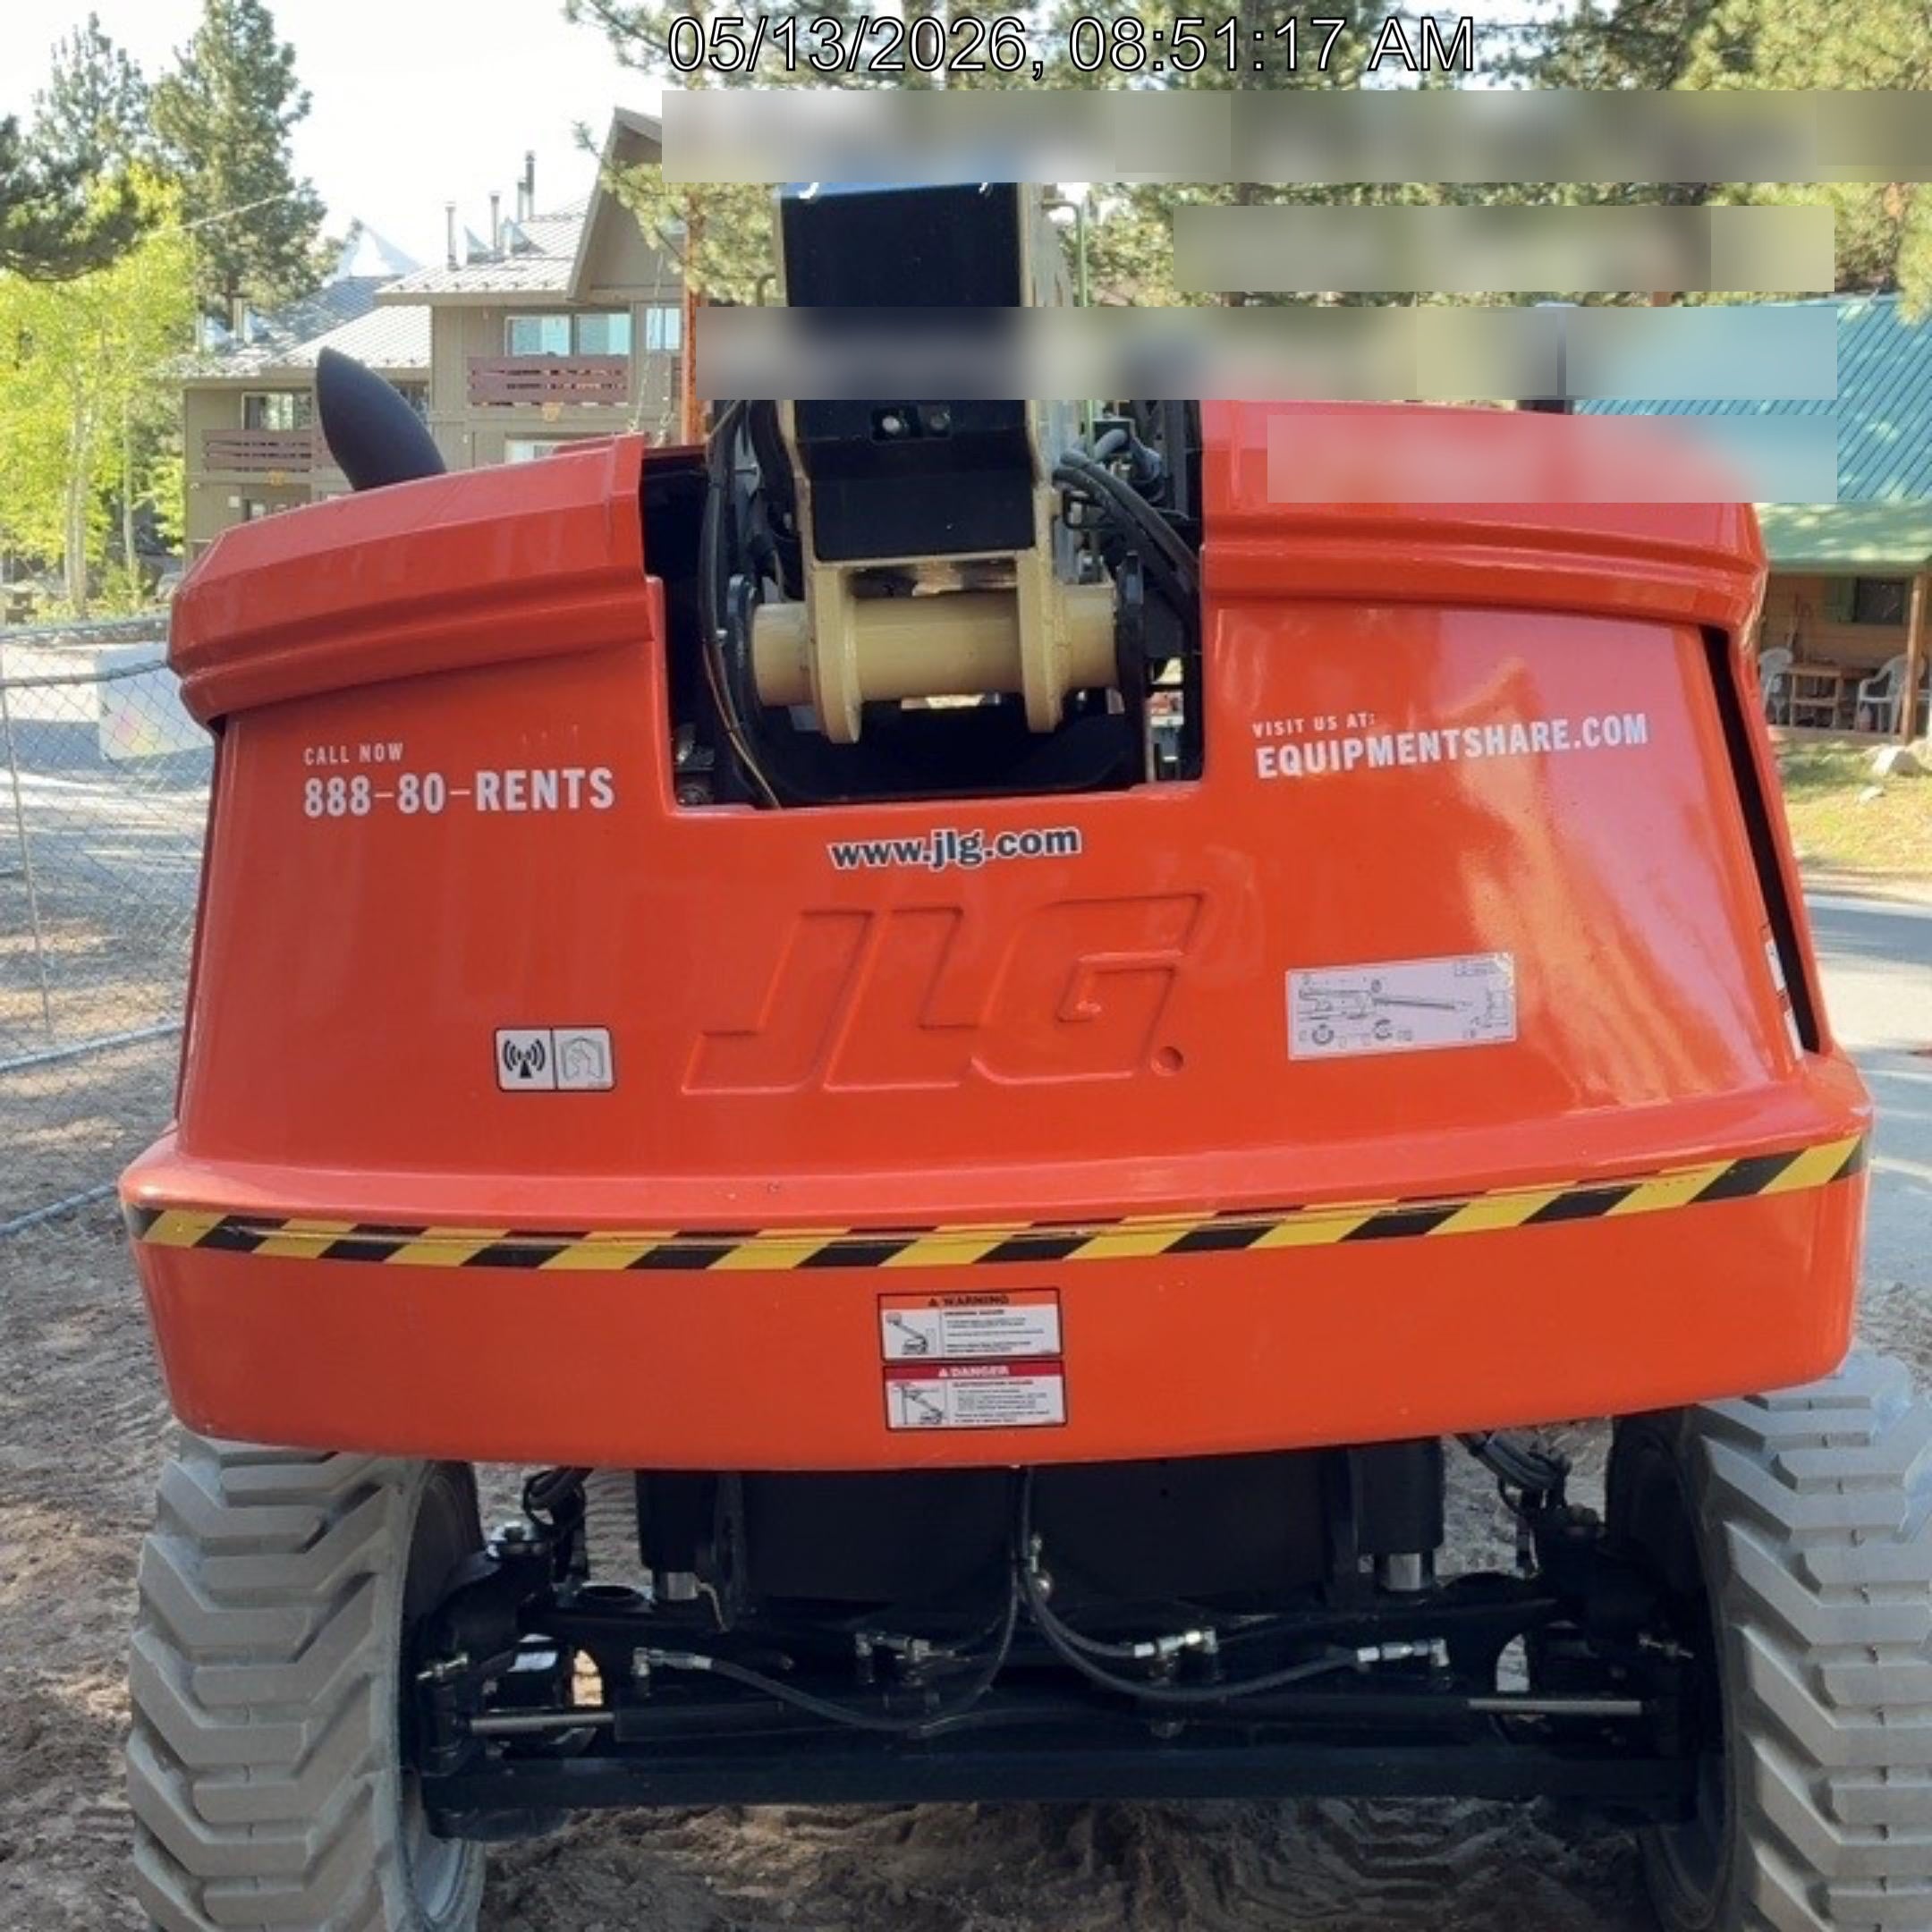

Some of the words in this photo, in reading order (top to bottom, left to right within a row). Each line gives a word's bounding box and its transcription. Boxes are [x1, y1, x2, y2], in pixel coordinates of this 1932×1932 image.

[1252, 718, 1304, 738] VISIT
[1314, 716, 1338, 732] US
[1346, 712, 1376, 729] AT:
[1255, 713, 1649, 779] EQUIPMENTSHARE.COM
[304, 745, 351, 766] CALL
[359, 742, 403, 762] NOW
[304, 767, 614, 818] 888-80-RENTS
[827, 826, 1081, 872] www.jlg.com
